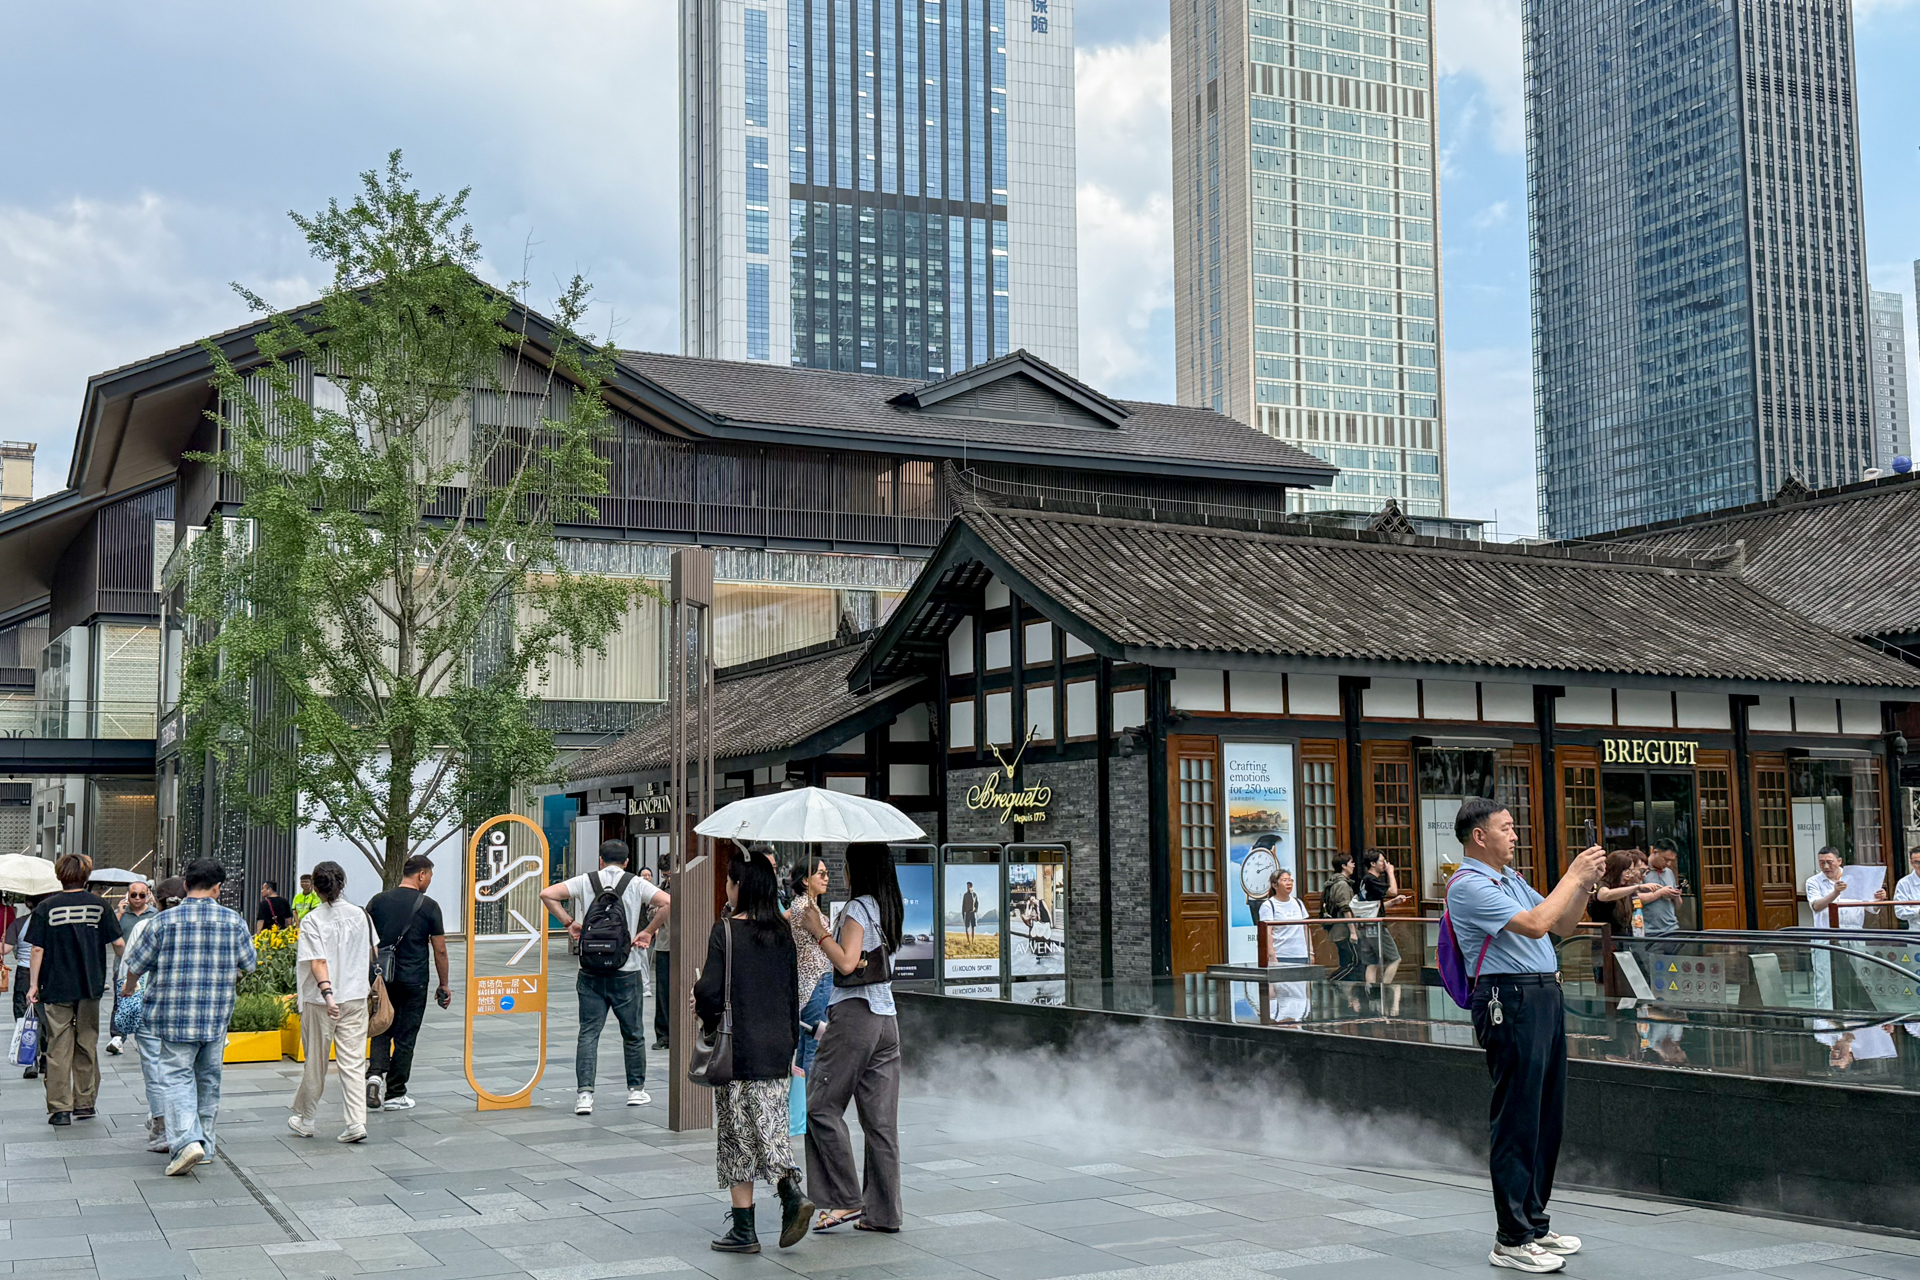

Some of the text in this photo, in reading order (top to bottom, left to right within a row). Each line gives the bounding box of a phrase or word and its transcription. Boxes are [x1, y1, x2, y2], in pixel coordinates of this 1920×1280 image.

[1031, 0, 1048, 34] 保险
[1602, 738, 1699, 765] BREGUET
[1229, 760, 1267, 774] Crafting
[1229, 772, 1271, 782] emotions
[1230, 784, 1287, 797] for 250 years
[966, 769, 1052, 825] Breguet
[628, 795, 672, 816] BLANCPAIN
[1013, 812, 1033, 824] Depuis
[1427, 821, 1455, 830] BREGUE
[1796, 823, 1821, 831] BREGUET
[976, 964, 993, 972] SPORT
[478, 979, 520, 989] 商场负一层
[477, 988, 505, 996] BASEMENT
[478, 996, 495, 1006] 地铁
